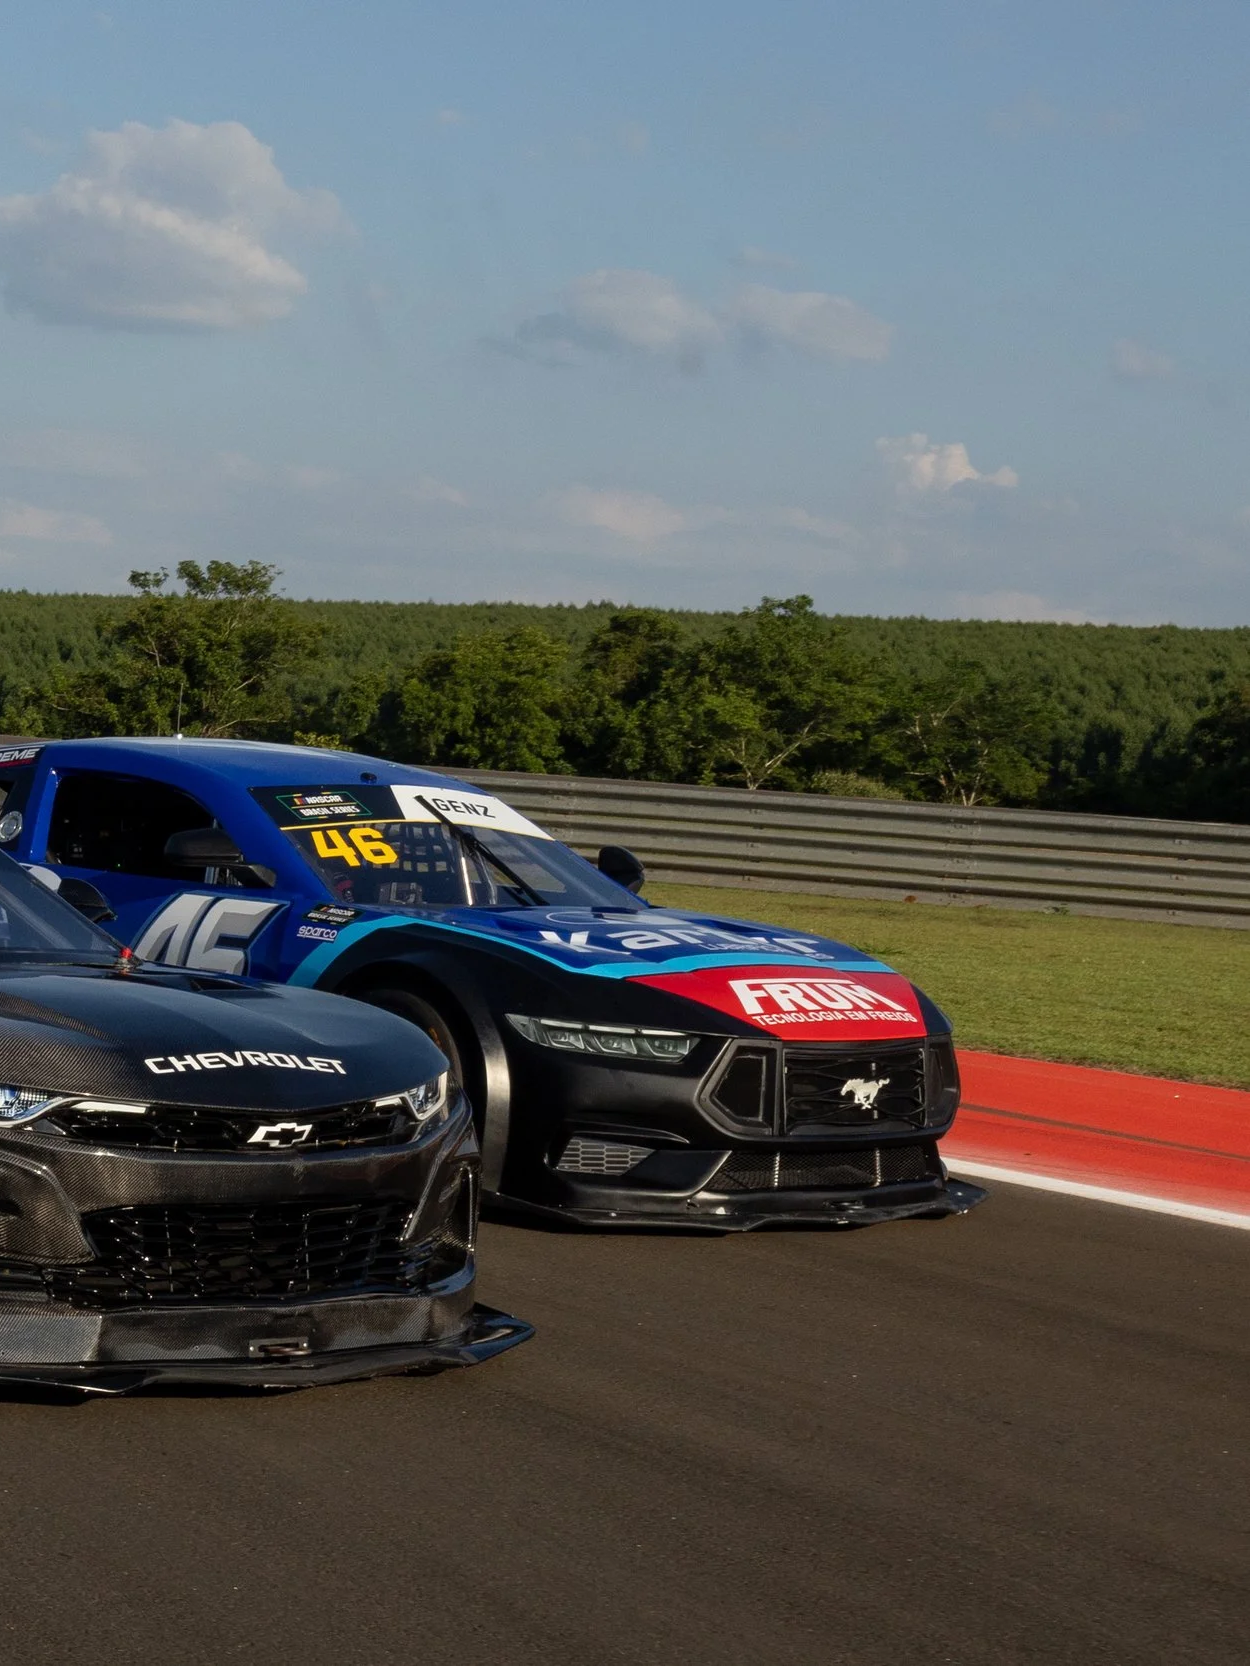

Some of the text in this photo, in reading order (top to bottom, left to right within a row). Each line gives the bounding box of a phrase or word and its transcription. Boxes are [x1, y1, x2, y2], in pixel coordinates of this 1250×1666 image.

[305, 795, 343, 804] NASCAR
[431, 798, 496, 818] GENZ
[299, 806, 361, 816] BRASIL SERIES
[311, 827, 398, 867] 46
[298, 925, 337, 939] sparco
[728, 977, 907, 1015] FRUM
[752, 1010, 918, 1026] TECNOLOGIA EM FREIOS
[144, 1051, 347, 1074] CHEVROLET
